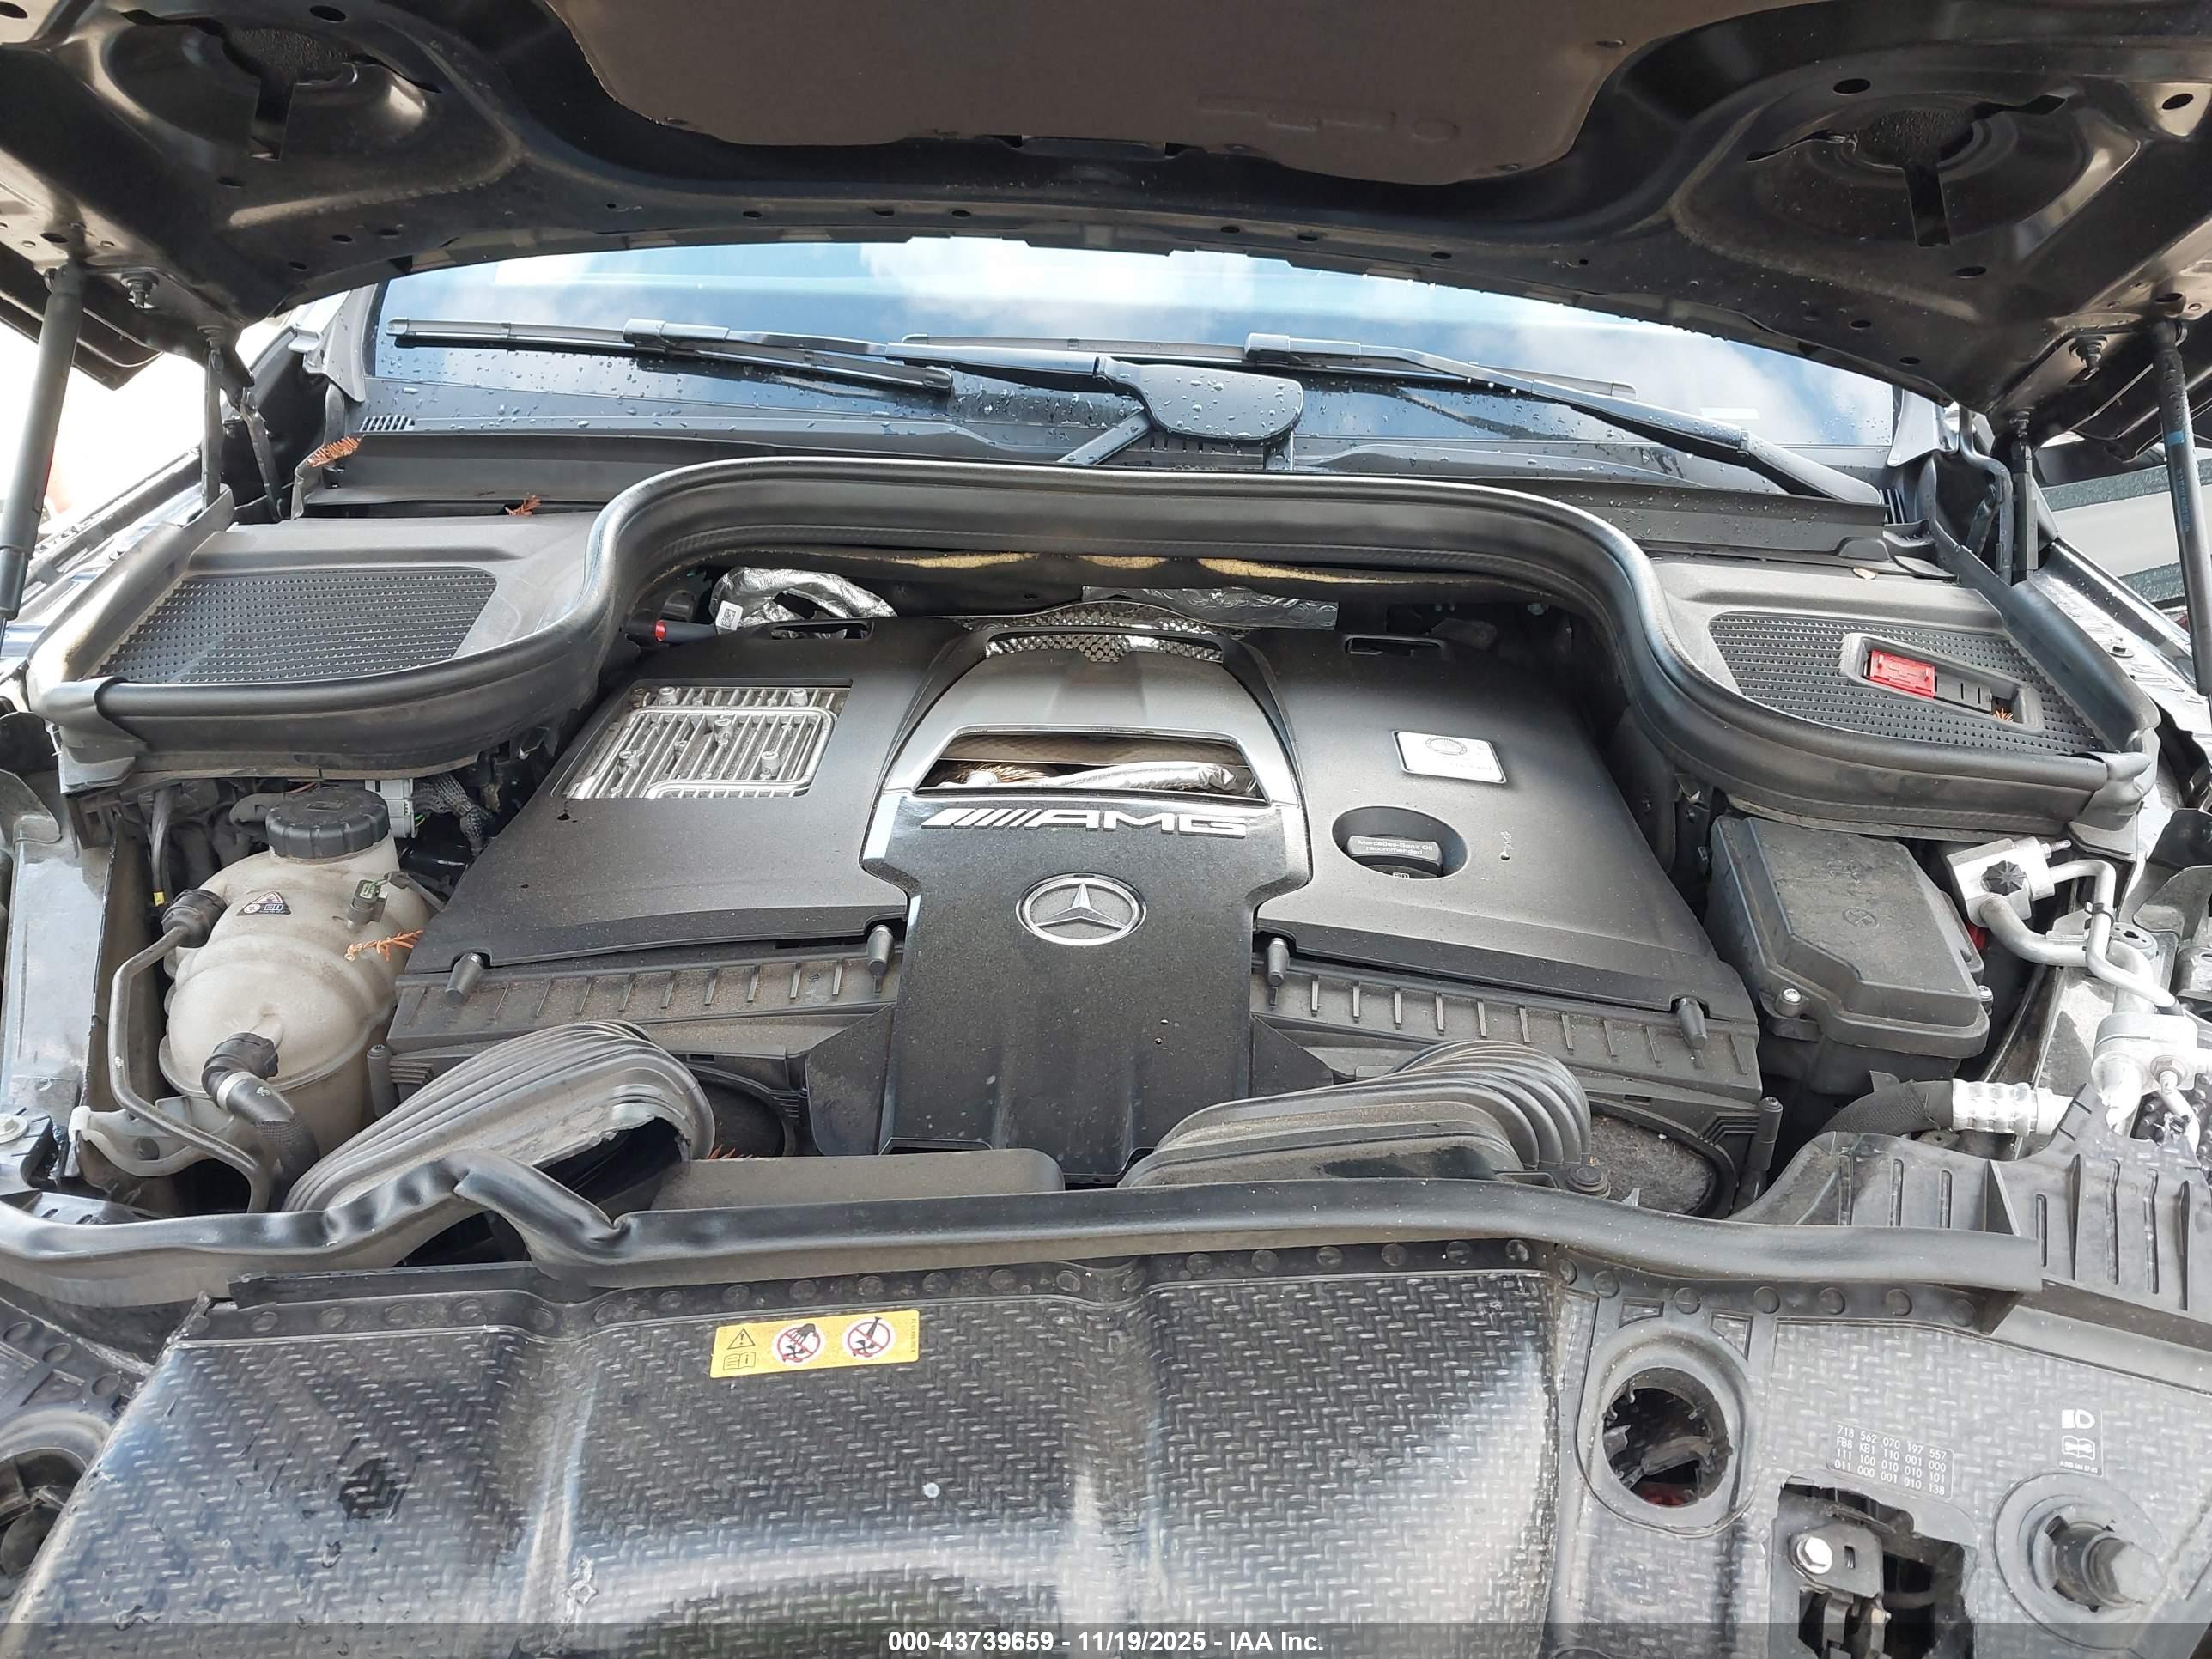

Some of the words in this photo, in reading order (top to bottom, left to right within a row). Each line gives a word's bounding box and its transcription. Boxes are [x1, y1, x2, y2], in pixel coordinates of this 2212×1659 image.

[1024, 809, 1246, 839] AMG
[1358, 839, 1419, 849] Mercedes-Benz
[1365, 846, 1423, 855] recommended
[1837, 1425, 1854, 1437] 718
[1860, 1431, 1877, 1443] 562
[1882, 1437, 1900, 1449] 070
[1907, 1443, 1923, 1455] 197
[1929, 1449, 1947, 1460] 557
[1837, 1449, 1851, 1460] 111
[1860, 1455, 1875, 1466] 100
[1881, 1461, 1899, 1472] 010
[1905, 1467, 1922, 1478] 010
[1929, 1472, 1945, 1483] 101
[1884, 1449, 1899, 1461] 110
[1905, 1455, 1922, 1466] 001
[1929, 1461, 1946, 1472] 000
[1834, 1460, 1851, 1471] 011
[1857, 1466, 1875, 1477] 000
[1881, 1472, 1897, 1483] 001
[1904, 1478, 1922, 1489] 010
[1929, 1484, 1945, 1495] 138
